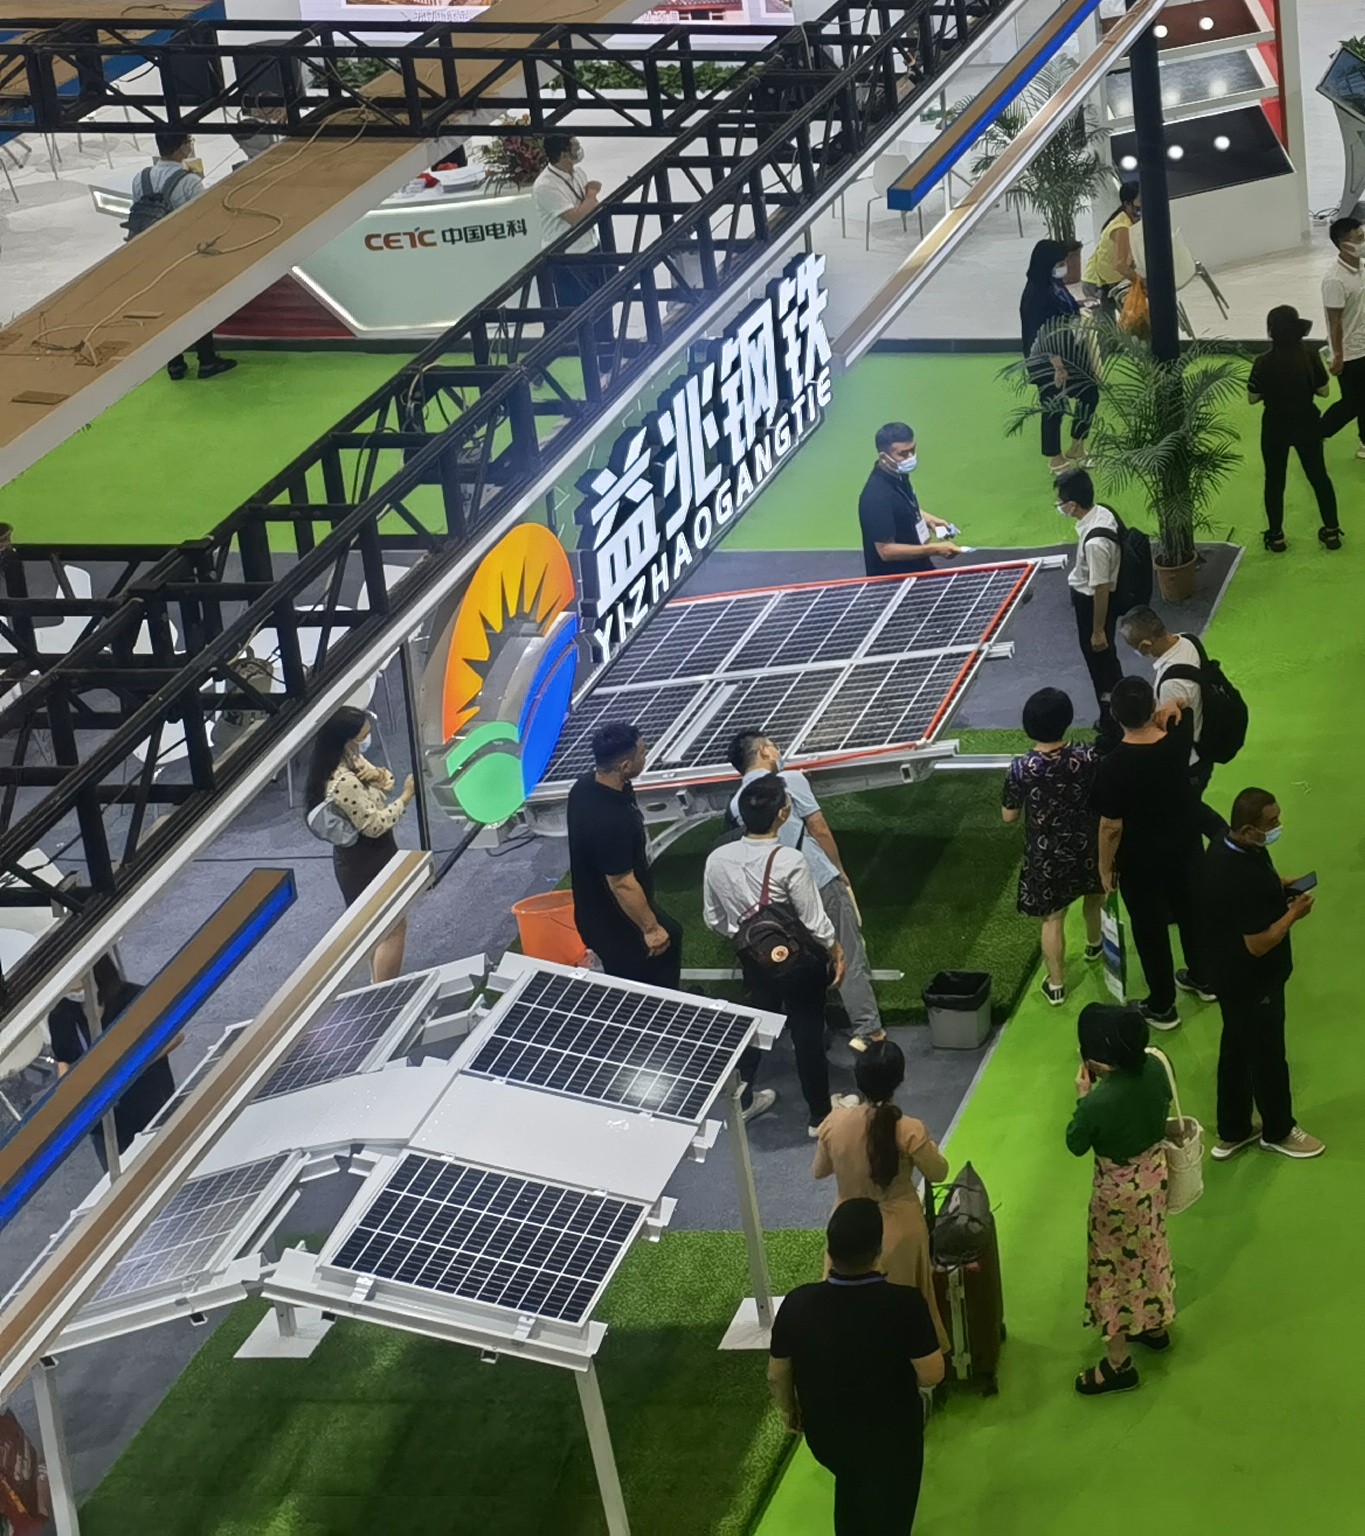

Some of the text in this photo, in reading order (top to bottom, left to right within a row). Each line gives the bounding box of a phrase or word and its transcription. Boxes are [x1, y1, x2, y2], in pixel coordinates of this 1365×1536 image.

[364, 225, 438, 252] CETC
[440, 218, 529, 247] 中国电科
